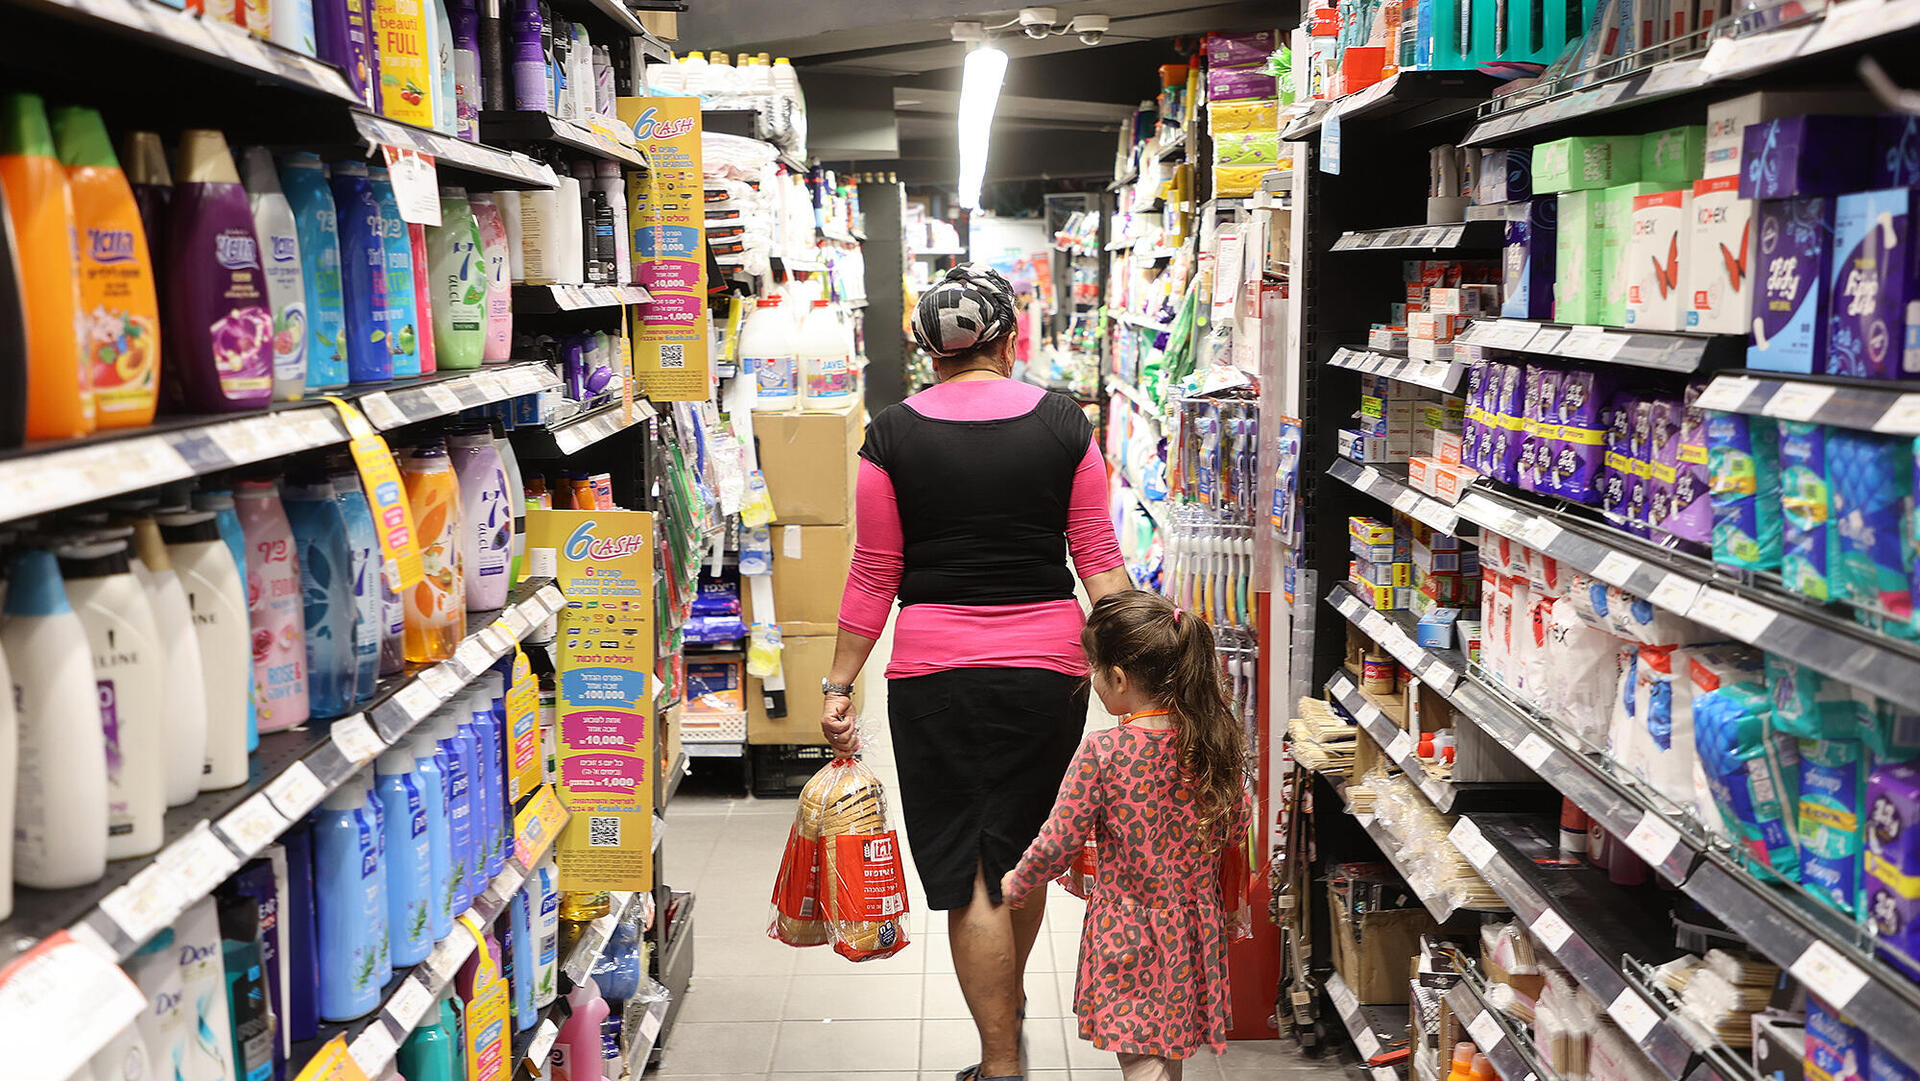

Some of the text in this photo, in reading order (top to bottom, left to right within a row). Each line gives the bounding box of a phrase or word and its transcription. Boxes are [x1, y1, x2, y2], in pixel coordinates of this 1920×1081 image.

[380, 15, 417, 30] beauti
[387, 32, 419, 56] FULL
[634, 107, 695, 140] 6 CASH
[649, 145, 657, 153] 6
[564, 520, 644, 561] 6 CASH
[585, 567, 594, 576] 6
